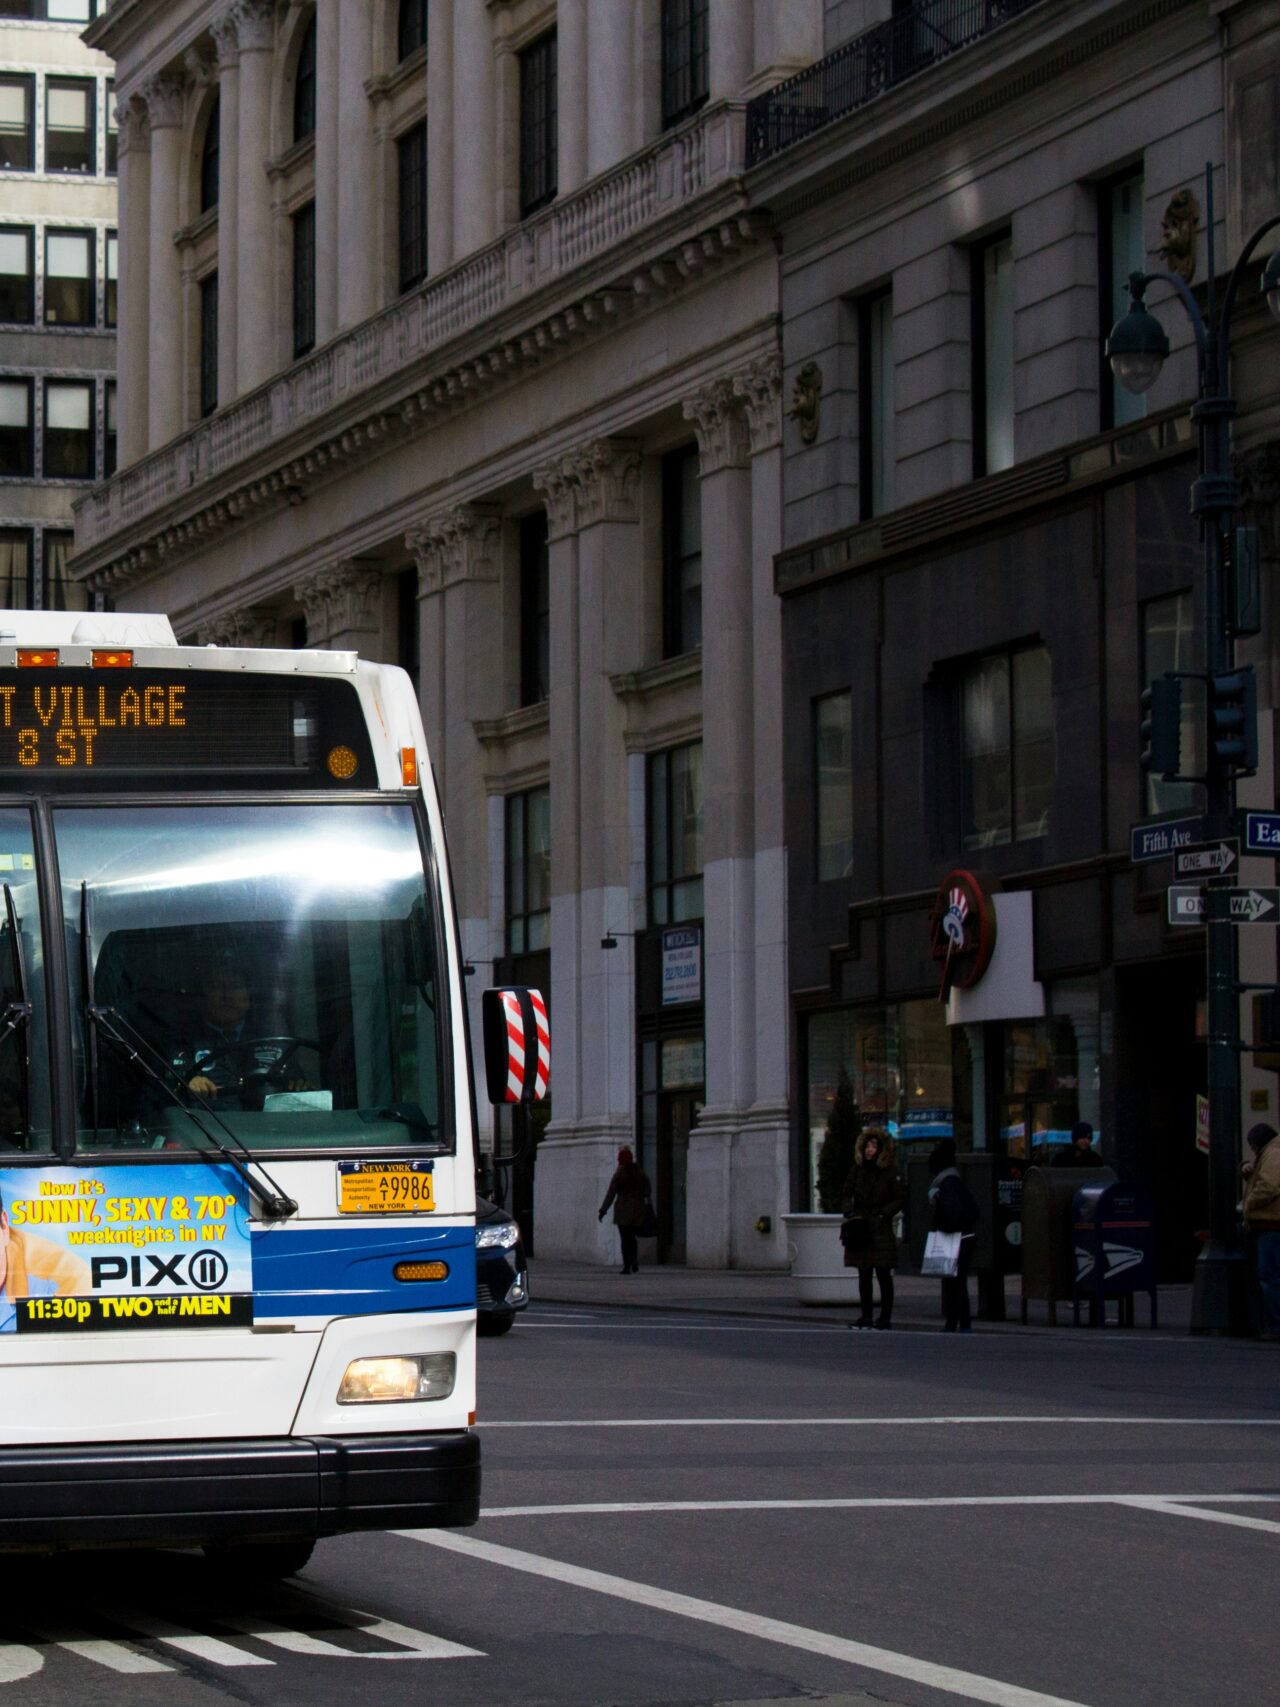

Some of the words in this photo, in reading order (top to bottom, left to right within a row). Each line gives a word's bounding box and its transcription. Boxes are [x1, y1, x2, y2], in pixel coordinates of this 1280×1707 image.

[34, 686, 186, 726] VILLAGE
[18, 729, 39, 765] 8
[56, 729, 98, 765] ST
[1143, 831, 1169, 853] Fifth
[1170, 829, 1192, 848] Ave
[1183, 855, 1202, 869] ONE
[1209, 851, 1229, 866] WAY
[1185, 898, 1207, 912] ON
[1231, 898, 1264, 912] WAY
[362, 1165, 385, 1173] NEW
[387, 1164, 411, 1172] YORK
[39, 1181, 76, 1196] Now
[78, 1179, 106, 1195] it's
[10, 1199, 102, 1227] SUNNY,
[105, 1196, 168, 1222] SEXY
[170, 1196, 191, 1221] &
[193, 1194, 237, 1220] 70°
[67, 1224, 176, 1248] weeknights
[179, 1224, 197, 1242] in
[201, 1224, 227, 1241] NY
[91, 1254, 188, 1289] PIX
[27, 1298, 91, 1323] 11:30p
[99, 1296, 154, 1318] TWO
[154, 1296, 171, 1306] and
[179, 1295, 232, 1317] MEN
[157, 1305, 178, 1315] half
